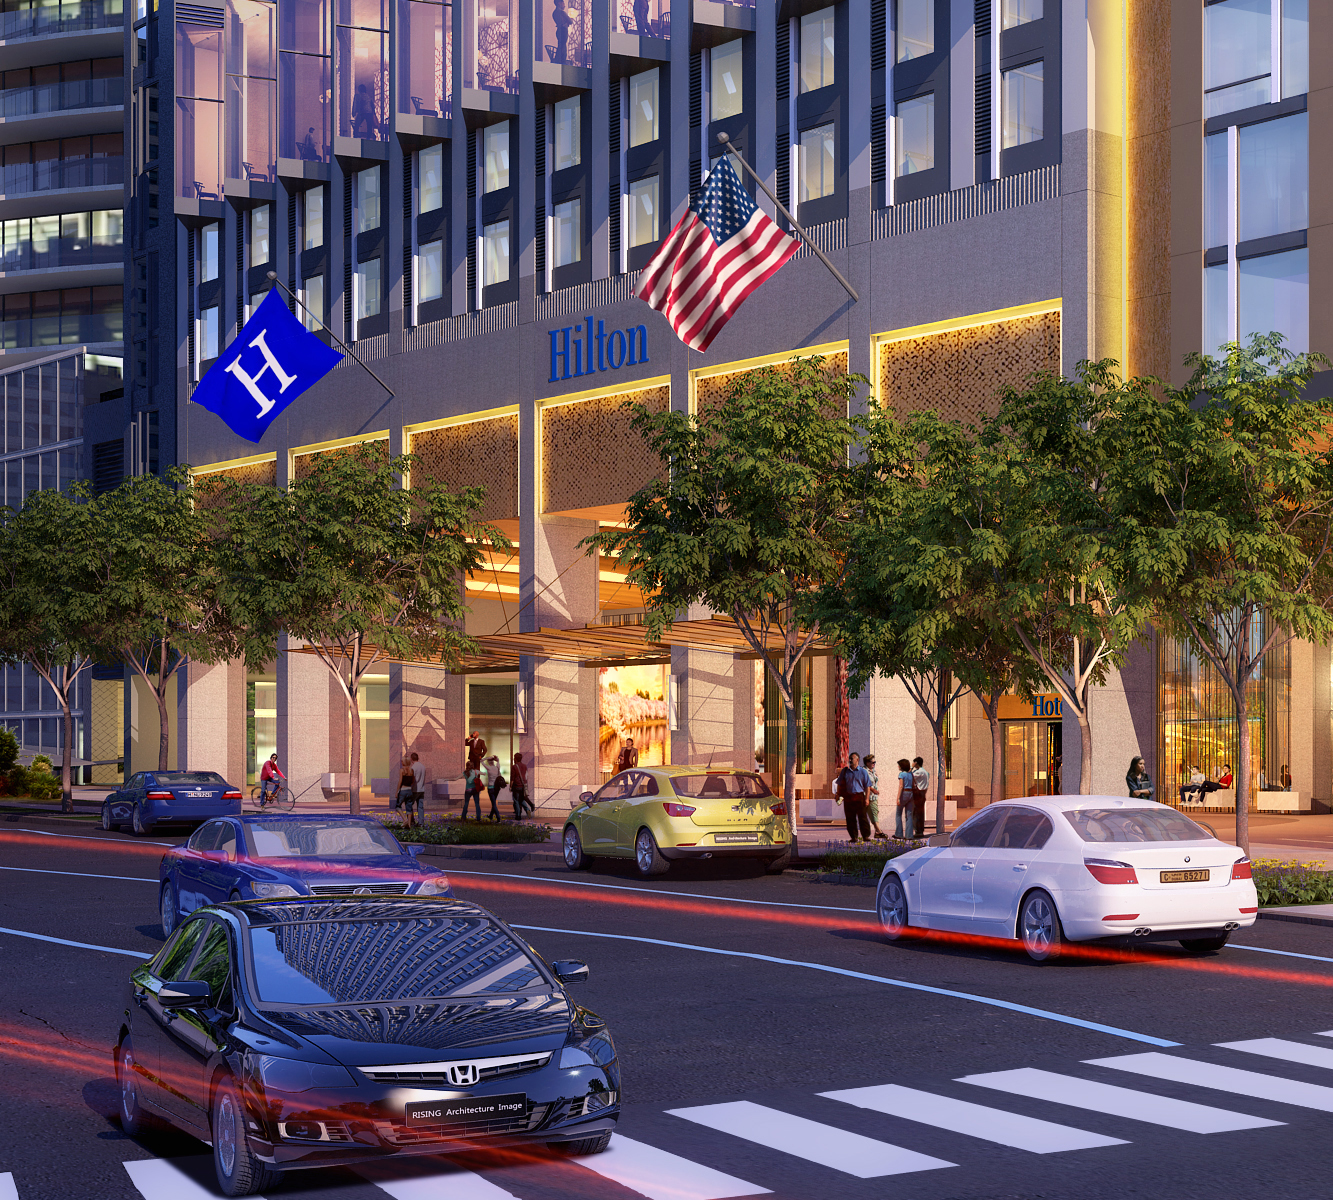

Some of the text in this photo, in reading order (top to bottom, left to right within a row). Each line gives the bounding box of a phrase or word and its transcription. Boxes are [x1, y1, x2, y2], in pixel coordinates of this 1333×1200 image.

[548, 315, 650, 383] Hilton
[224, 328, 298, 419] H
[1183, 871, 1207, 881] 65271
[412, 1102, 523, 1119] RISING Architecture Image
